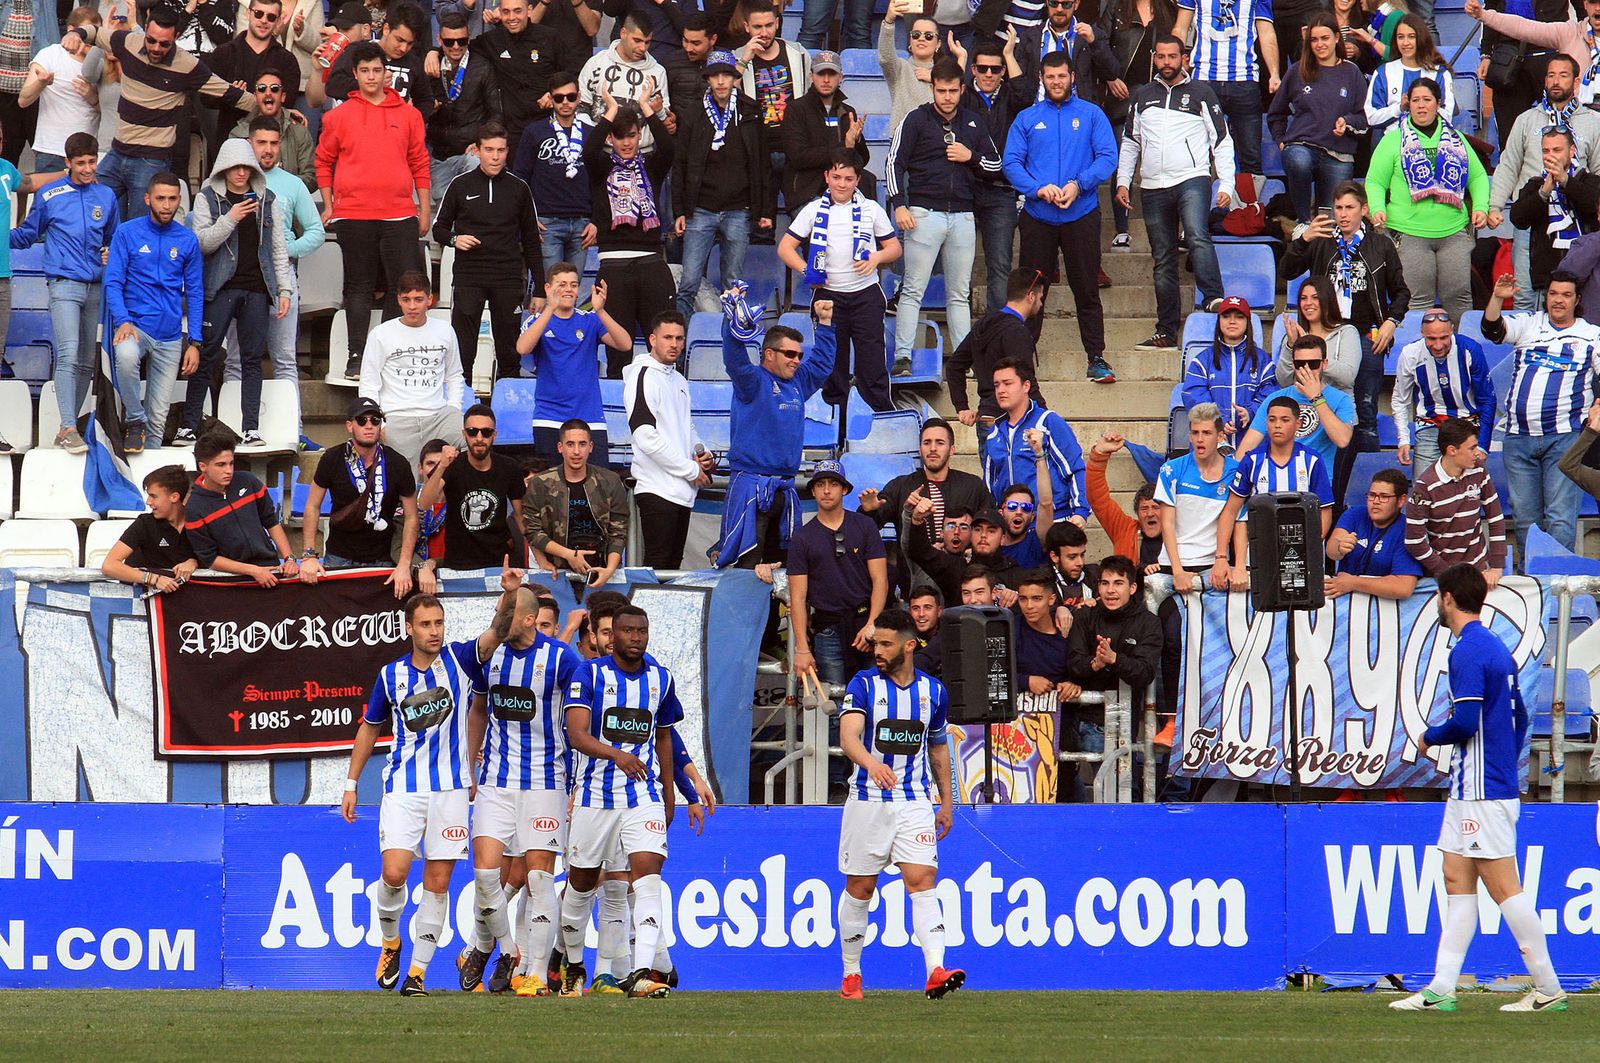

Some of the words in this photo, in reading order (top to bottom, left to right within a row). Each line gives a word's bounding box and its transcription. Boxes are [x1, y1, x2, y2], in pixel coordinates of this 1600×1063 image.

[404, 379, 437, 387] TIME
[179, 609, 409, 659] ABOCREW
[242, 684, 301, 703] Siempre
[303, 681, 363, 702] Presente
[1183, 592, 1398, 787] 1889
[404, 697, 450, 721] Huelva
[493, 693, 533, 710] Huelva
[249, 710, 290, 730] 1985
[310, 707, 352, 727] 2010
[606, 715, 649, 732] Huelva
[879, 727, 921, 743] Huelva
[1184, 727, 1277, 769] Forza
[1284, 735, 1387, 775] Recre
